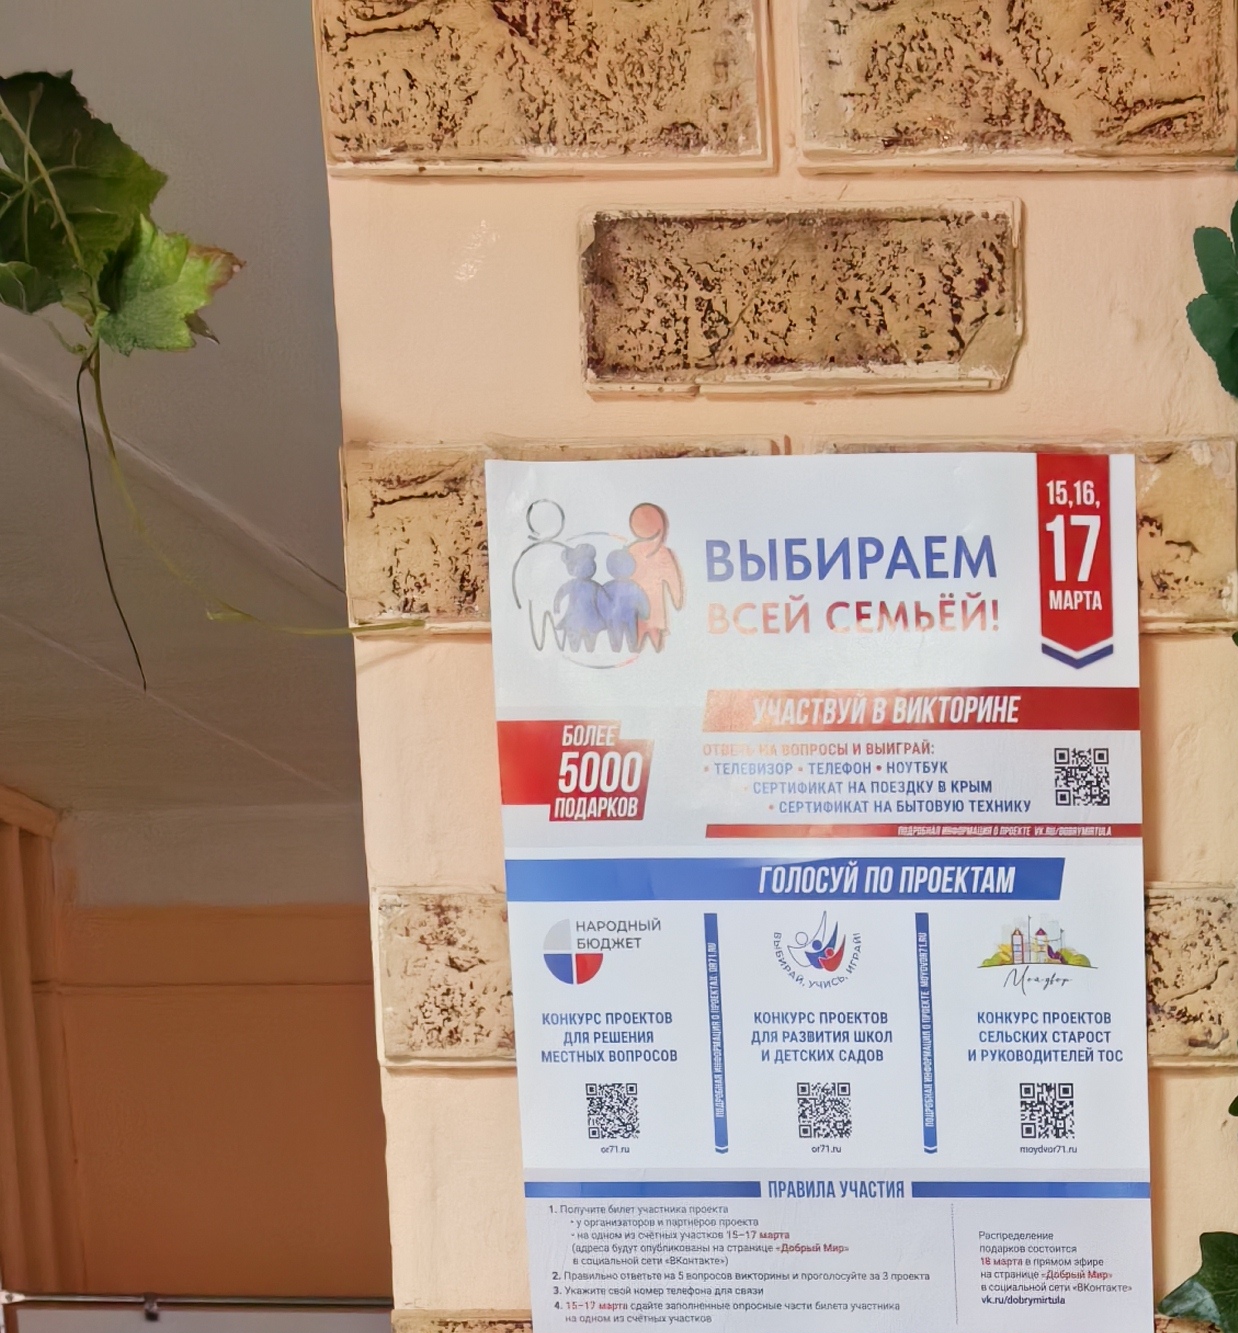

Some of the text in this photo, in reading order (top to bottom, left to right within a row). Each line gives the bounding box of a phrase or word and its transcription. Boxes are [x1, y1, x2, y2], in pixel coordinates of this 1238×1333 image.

[1046, 480, 1101, 507] 15,16,
[1045, 515, 1101, 582] 17
[705, 535, 997, 582] ВЫБИРАЕМ
[1049, 590, 1102, 611] МАРТА
[707, 592, 1000, 635] ВСЕЙ СЕМЬЁЙ!
[752, 692, 1021, 725] УЧАСТВУЙ В ВИКТОРИНЕ
[562, 725, 619, 746] БОЛЕЕ
[703, 744, 754, 757] ОТВЕЬ
[783, 743, 848, 756] ВОПРОСЫ
[853, 743, 861, 755] И
[866, 740, 935, 755] ВЫИГРАЙ:
[558, 751, 643, 793] 5000
[714, 761, 948, 775] ТЕЛЕВИЗОР ТЕЛЕФОН НОУТБУК
[753, 781, 992, 795] СЕРТИФИКАТ НА ПОЕЗДКУ В КРЫМ
[554, 797, 638, 820] ПОДАРКОВ
[779, 800, 1031, 813] СЕРТИФИКАТ НА БЫТОВУЮ ТЕХНИКУ
[759, 861, 1016, 893] ГОЛОСУЙ ПО ПРОЕКТАМ
[576, 918, 661, 933] НАРОДНЫЙ
[577, 938, 642, 951] БЮДЖЕТ
[774, 932, 862, 989] ВЫБИРАЙ, УЧИСЬ, ИГРАЙ!
[542, 1012, 673, 1025] КОНКУРС ПРОЕКТОВ
[754, 1012, 888, 1024] КОНКУРС ПРОЕКТОВ
[978, 1012, 1111, 1024] КОНКУРС ПРОЕКТОВ
[563, 1031, 654, 1046] ДЛЯ РЕШЕНИЯ
[751, 1031, 892, 1045] ДЛЯ РАЗВИТИЯ ШКОЛ
[979, 1031, 1111, 1043] СЕЛЬСКИХ СТАРОСТ
[541, 1049, 678, 1063] МЕСТНЫХ ВОПРОСОВ
[761, 1050, 883, 1064] И ДЕТСКИХ САДОВ
[968, 1047, 1123, 1064] И РУКОВОДИТЕЛЕЙ ТОС
[768, 1181, 904, 1198] ПРАВИЛА УЧАСТИЯ
[560, 1204, 728, 1215] Получите билет участника проекта
[584, 1219, 655, 1228] организаторов
[719, 1218, 758, 1227] проекта
[591, 1232, 622, 1241] одном
[680, 1231, 723, 1241] участков
[759, 1231, 790, 1241] марта
[979, 1231, 1054, 1240] Распределение
[572, 1243, 609, 1253] (адреса
[612, 1243, 637, 1253] будут
[640, 1243, 710, 1253] опубликованы
[727, 1244, 773, 1253] странице
[980, 1245, 1077, 1254] подарков состоится
[581, 1256, 638, 1266] социальной
[641, 1257, 662, 1265] сети
[993, 1258, 1023, 1267] марта
[1033, 1258, 1071, 1267] прямом
[1074, 1257, 1104, 1266] эфире
[563, 1271, 618, 1281] Правильно
[686, 1272, 732, 1281] вопросов
[735, 1272, 790, 1281] викторины
[801, 1271, 867, 1281] проголосуйте
[891, 1273, 930, 1281] проекта
[994, 1270, 1039, 1280] странице
[565, 1286, 763, 1296] Укажите свой номер телефона для связи
[988, 1282, 1046, 1292] социальной
[599, 1303, 628, 1312] марта
[630, 1301, 663, 1311] сдайте
[666, 1302, 730, 1310] заполненные
[733, 1302, 782, 1312] опросные
[784, 1302, 812, 1310] части
[815, 1301, 848, 1310] билета
[850, 1302, 900, 1312] участника
[981, 1296, 1066, 1306] vk.ru/dobrymirtula
[580, 1315, 610, 1323] одном
[669, 1315, 712, 1324] участков
